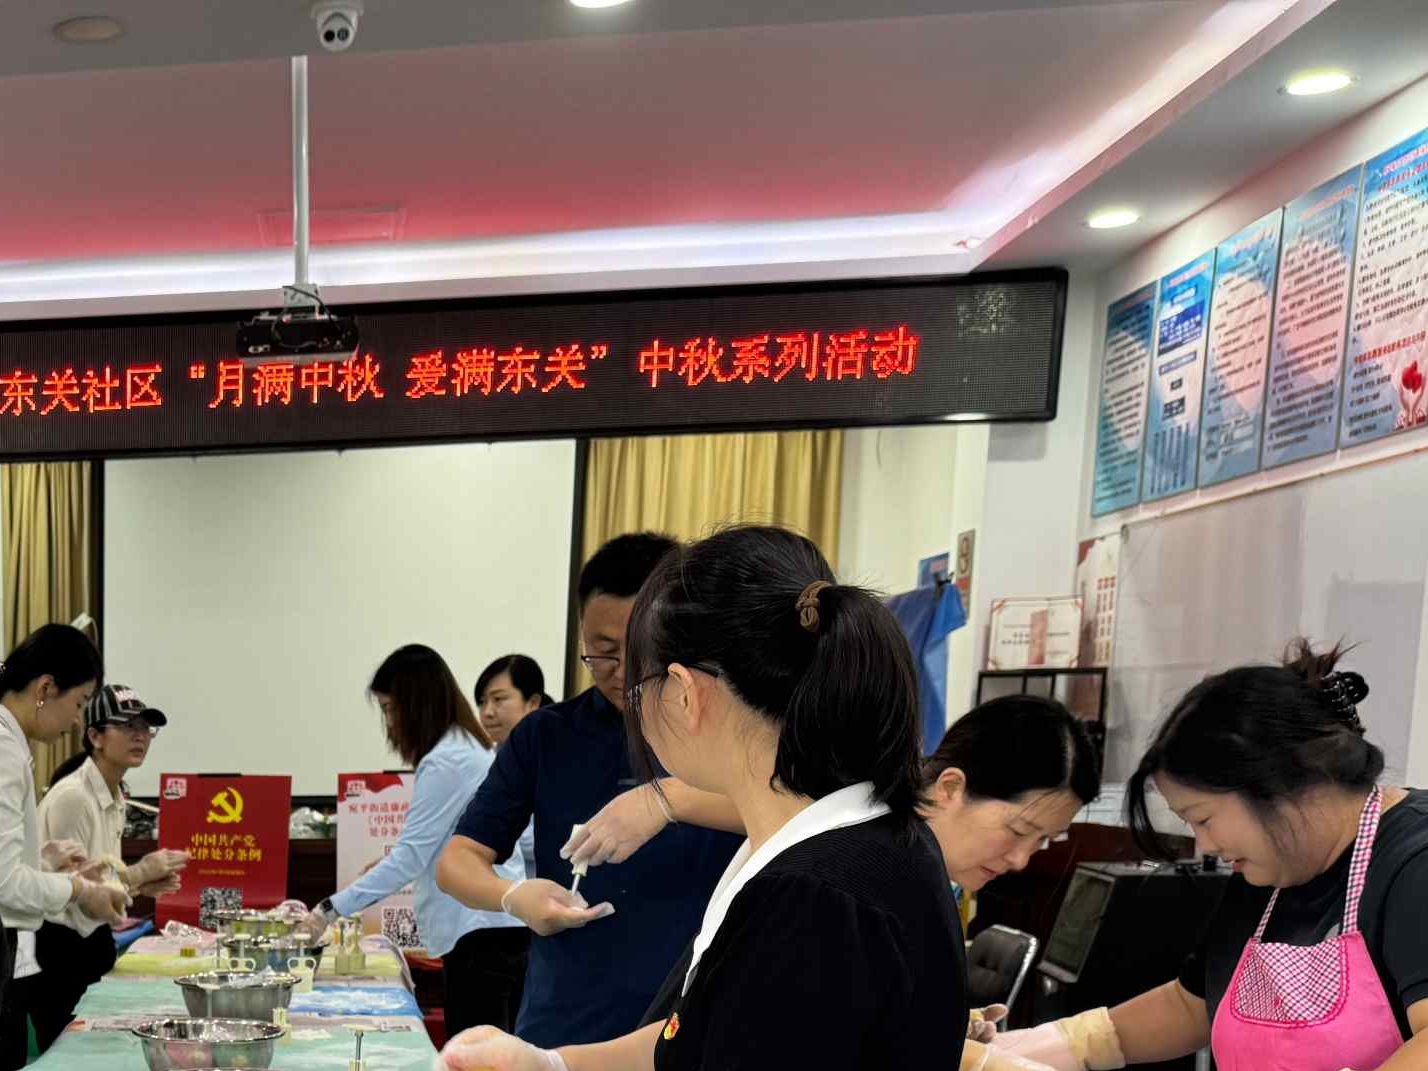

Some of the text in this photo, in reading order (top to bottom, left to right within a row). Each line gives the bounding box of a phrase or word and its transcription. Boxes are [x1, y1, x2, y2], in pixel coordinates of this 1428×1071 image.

[638, 323, 920, 389] 中秋系列活动
[190, 832, 257, 848] 中国共产党
